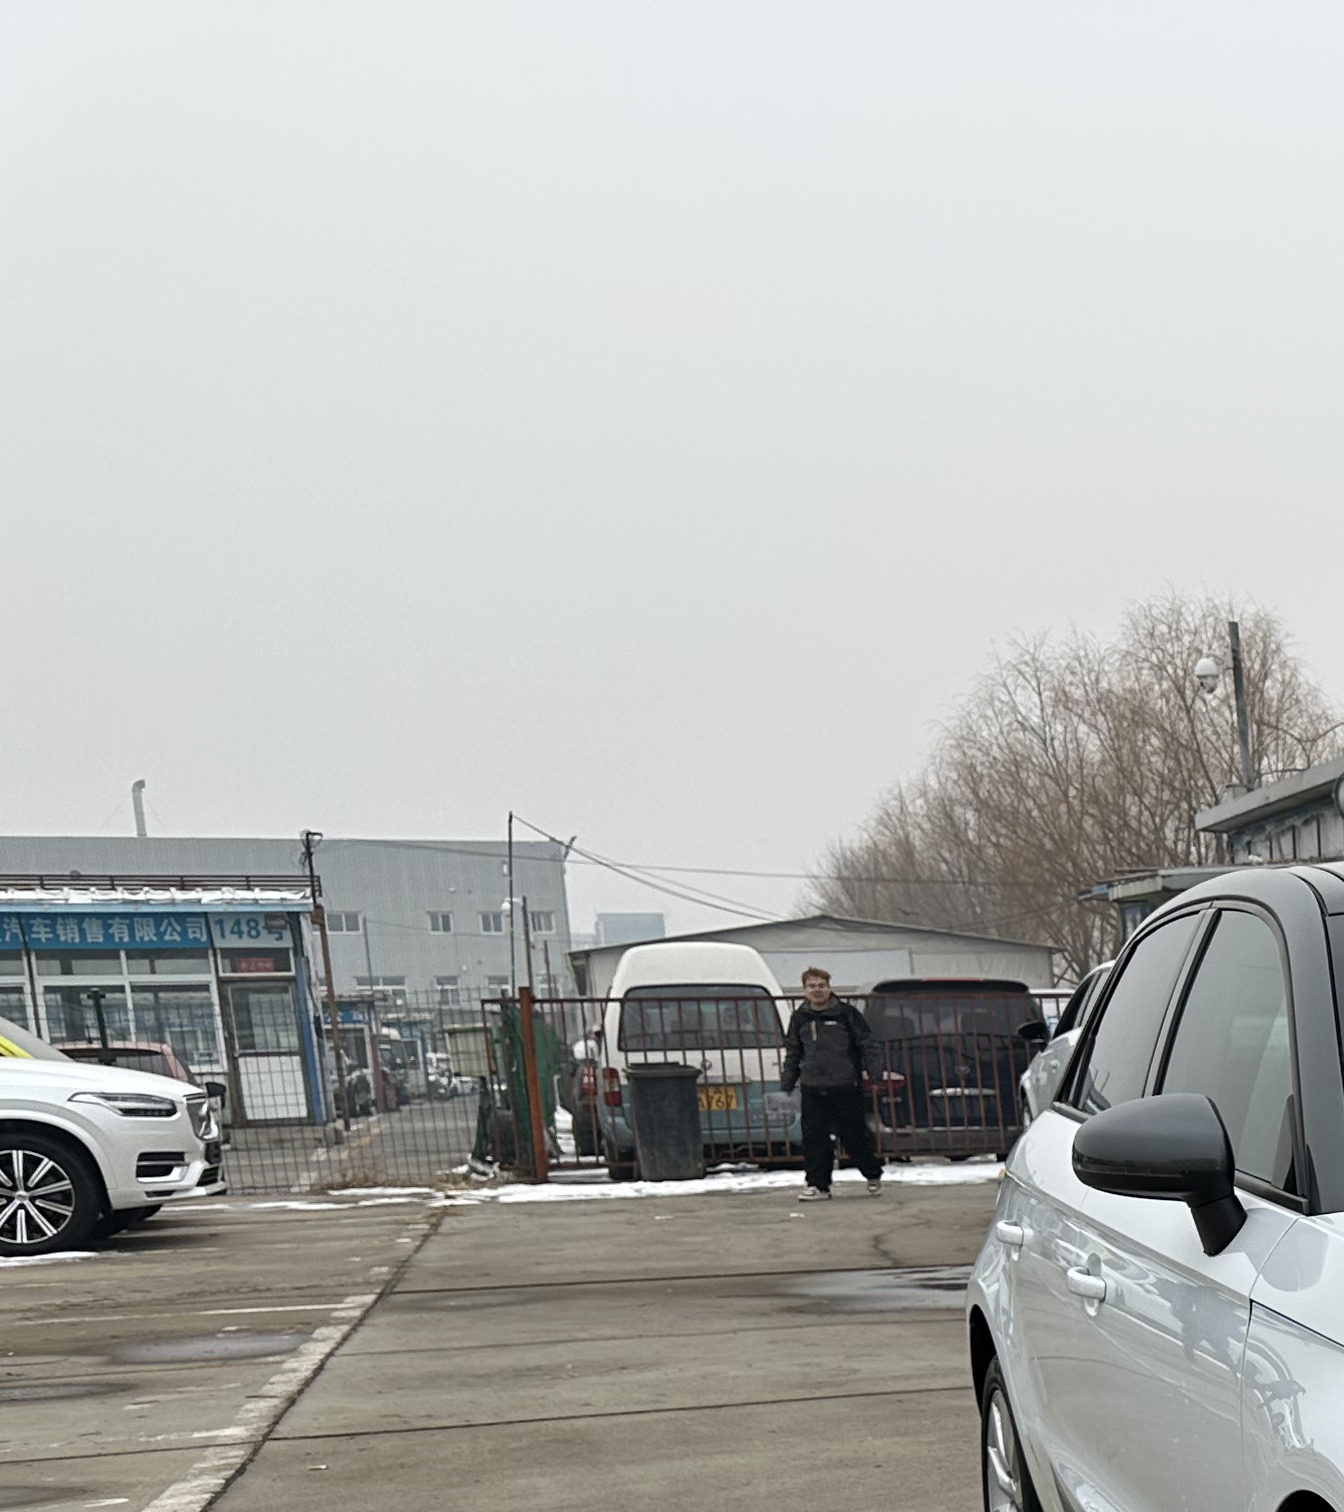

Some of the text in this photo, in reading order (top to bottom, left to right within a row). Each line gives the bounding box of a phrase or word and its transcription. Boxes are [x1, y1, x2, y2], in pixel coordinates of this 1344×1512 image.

[0, 916, 208, 943] 汽车销售有限公司
